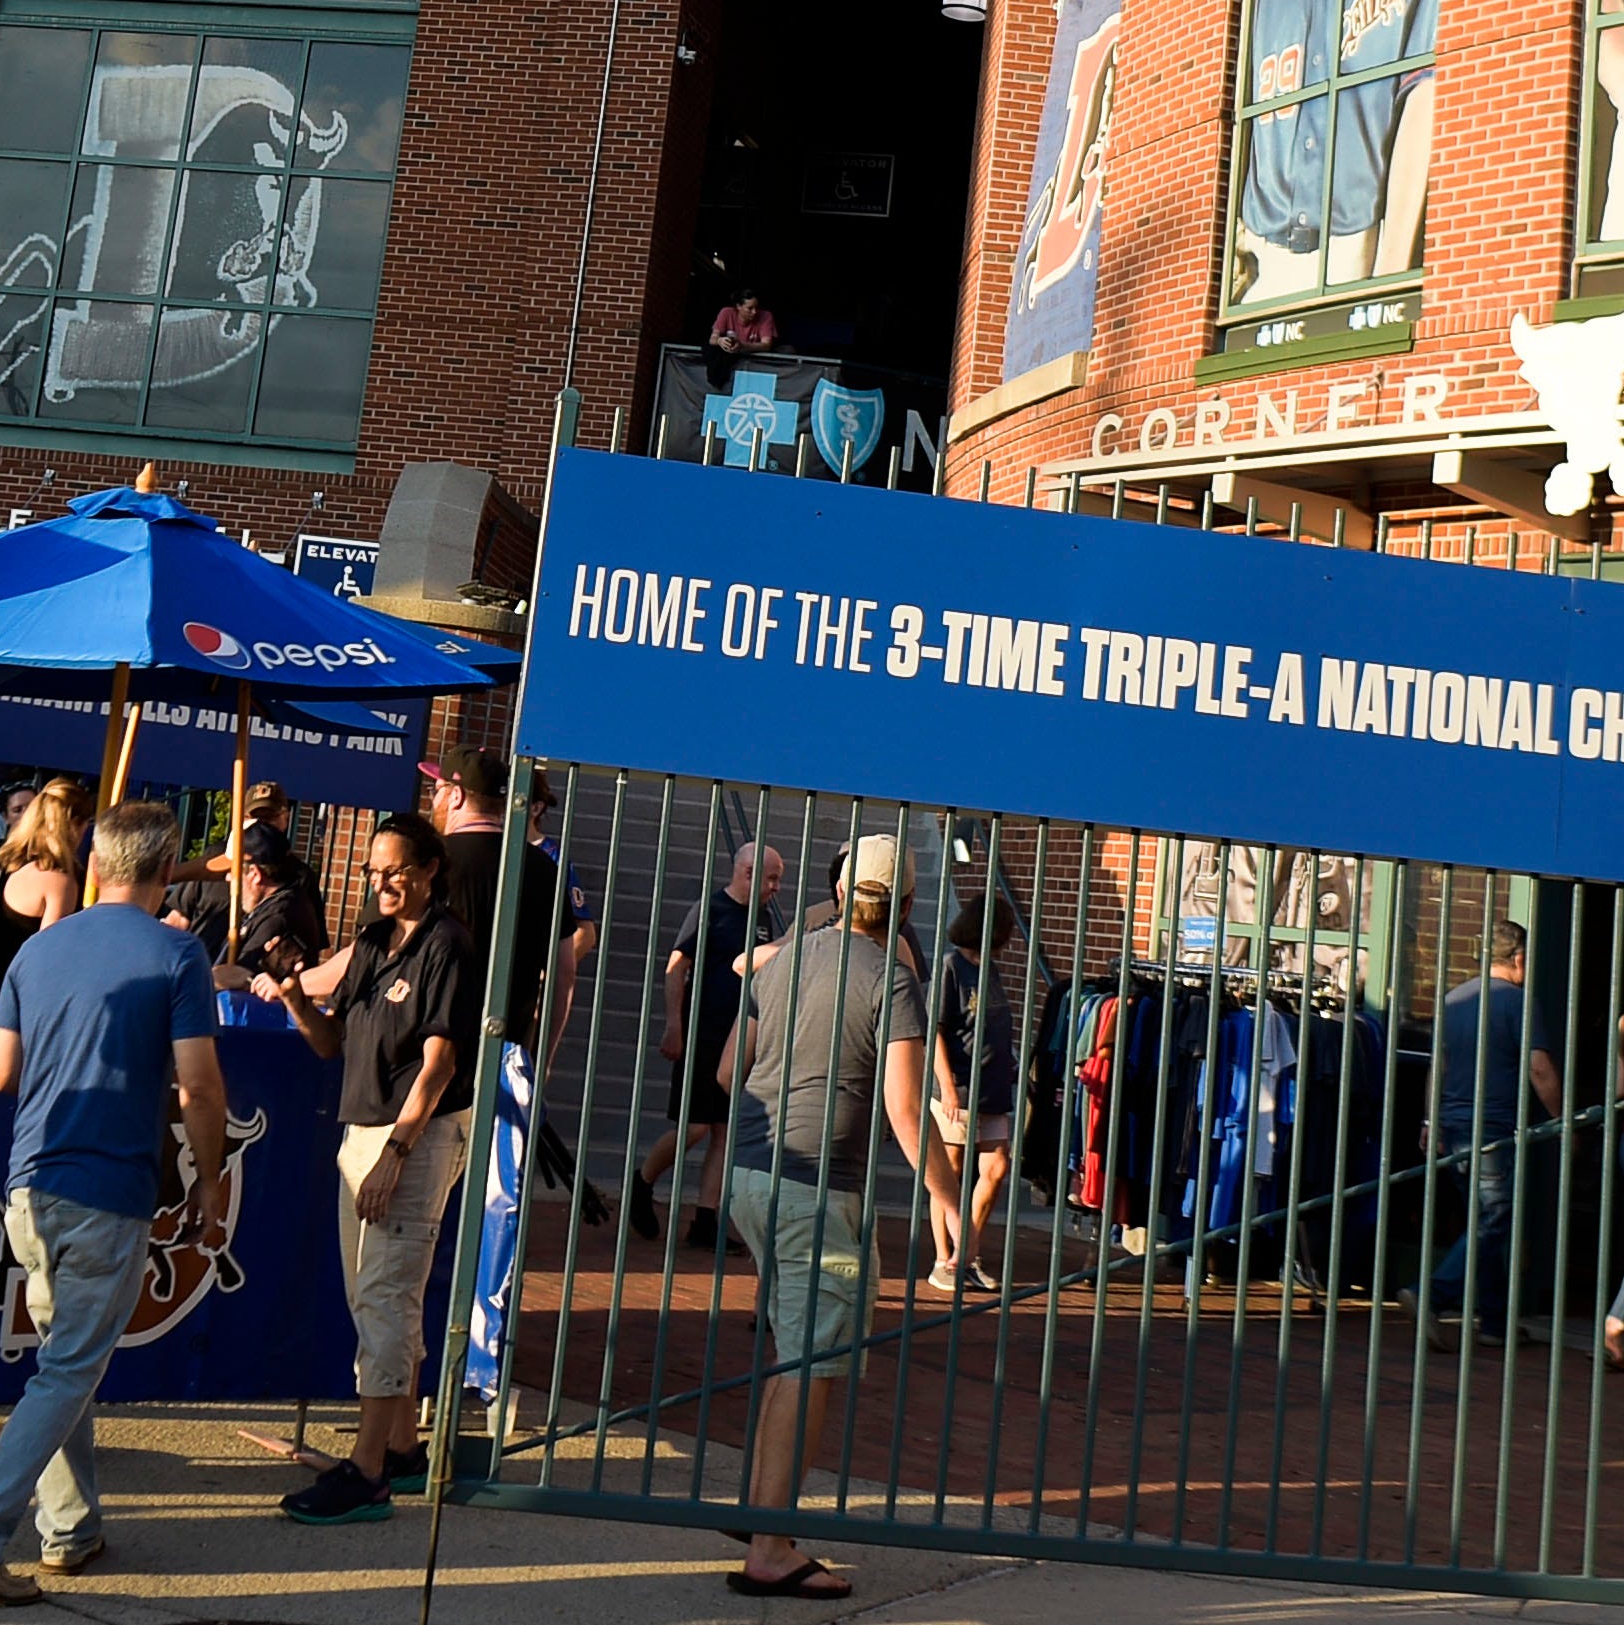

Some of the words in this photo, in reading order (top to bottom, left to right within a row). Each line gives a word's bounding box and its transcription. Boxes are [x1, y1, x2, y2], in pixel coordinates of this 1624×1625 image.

[1259, 43, 1303, 126] 29
[1285, 320, 1305, 343] NC
[1382, 302, 1406, 325] NC
[1091, 374, 1451, 462] CORNER
[568, 564, 712, 653] HOME
[721, 581, 783, 661] OF
[794, 590, 878, 674] THE
[885, 603, 1070, 697] 3-TIME
[1080, 627, 1305, 727] TRIPLE-A
[1317, 656, 1560, 756] NATIONAL
